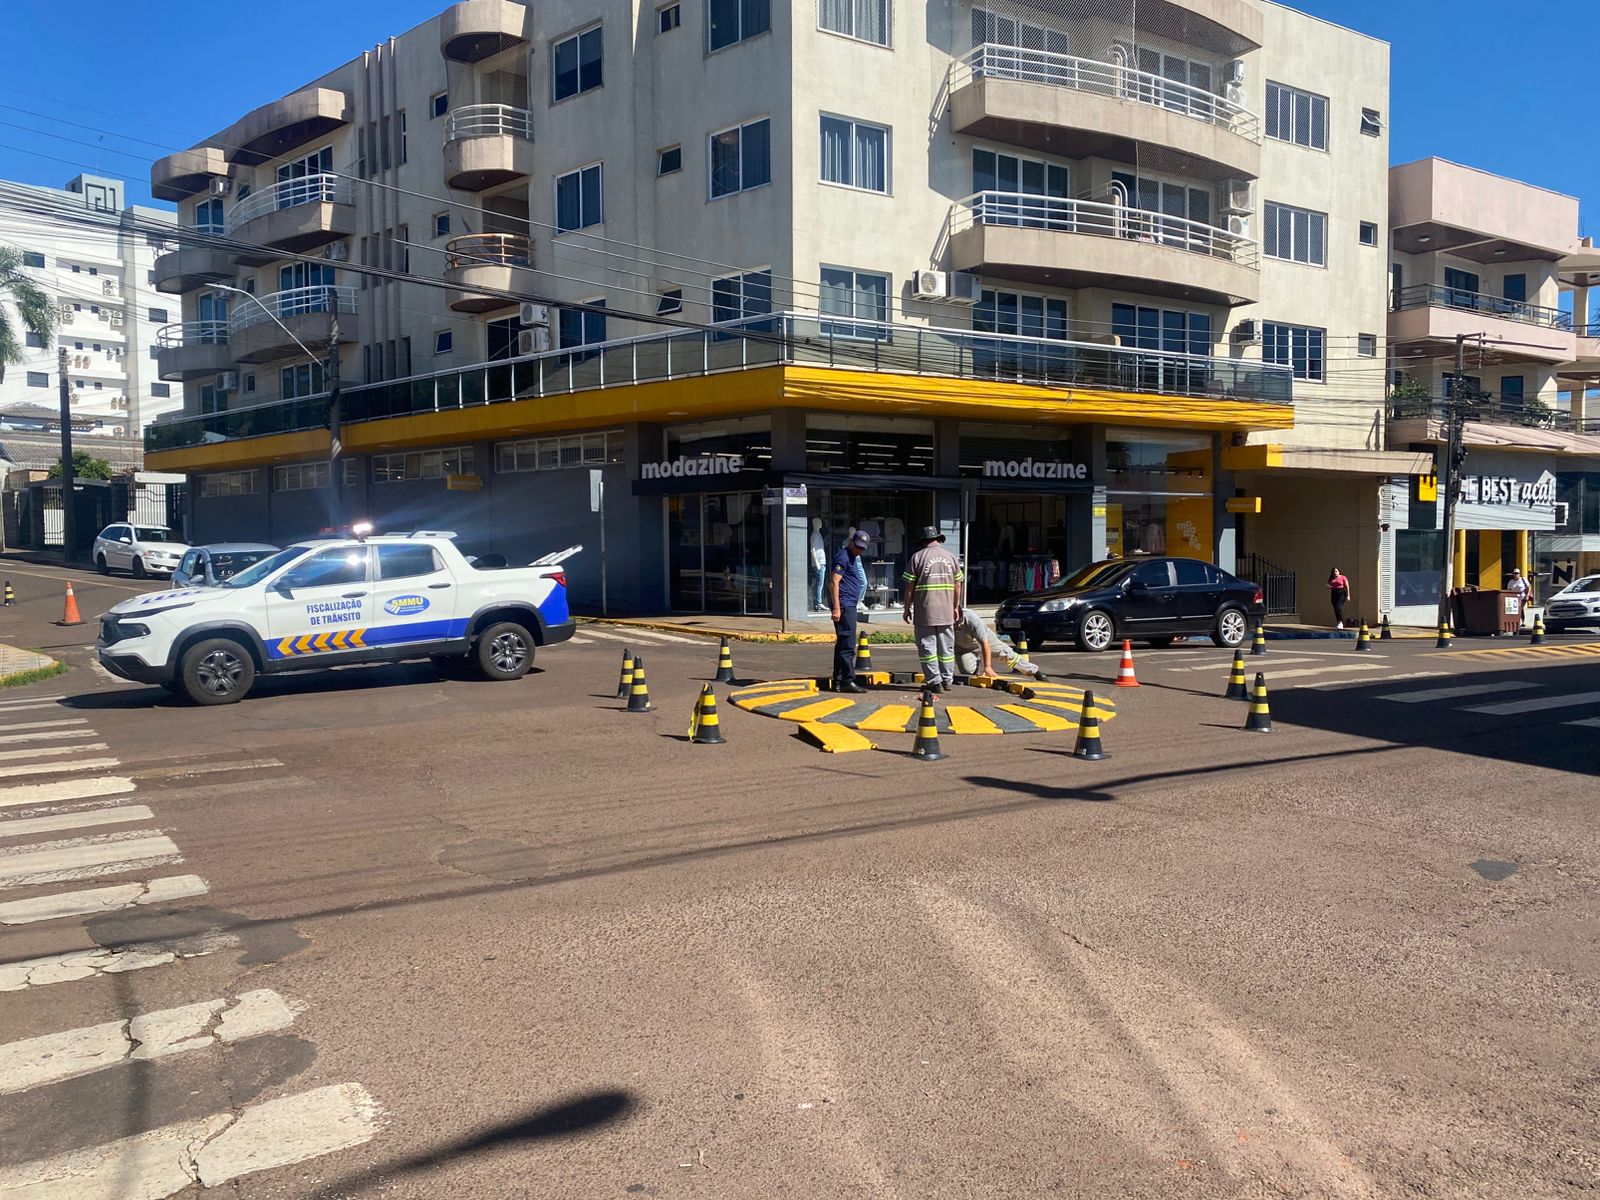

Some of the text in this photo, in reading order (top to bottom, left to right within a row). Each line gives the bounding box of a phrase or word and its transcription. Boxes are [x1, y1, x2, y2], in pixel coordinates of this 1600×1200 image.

[641, 455, 743, 479] modazine
[983, 457, 1087, 479] modazine
[1482, 476, 1517, 502] BEST
[306, 599, 362, 614] FISCALIZAÇÃO
[391, 597, 424, 608] SMMU
[310, 611, 361, 626] DE TRÂNSITO
